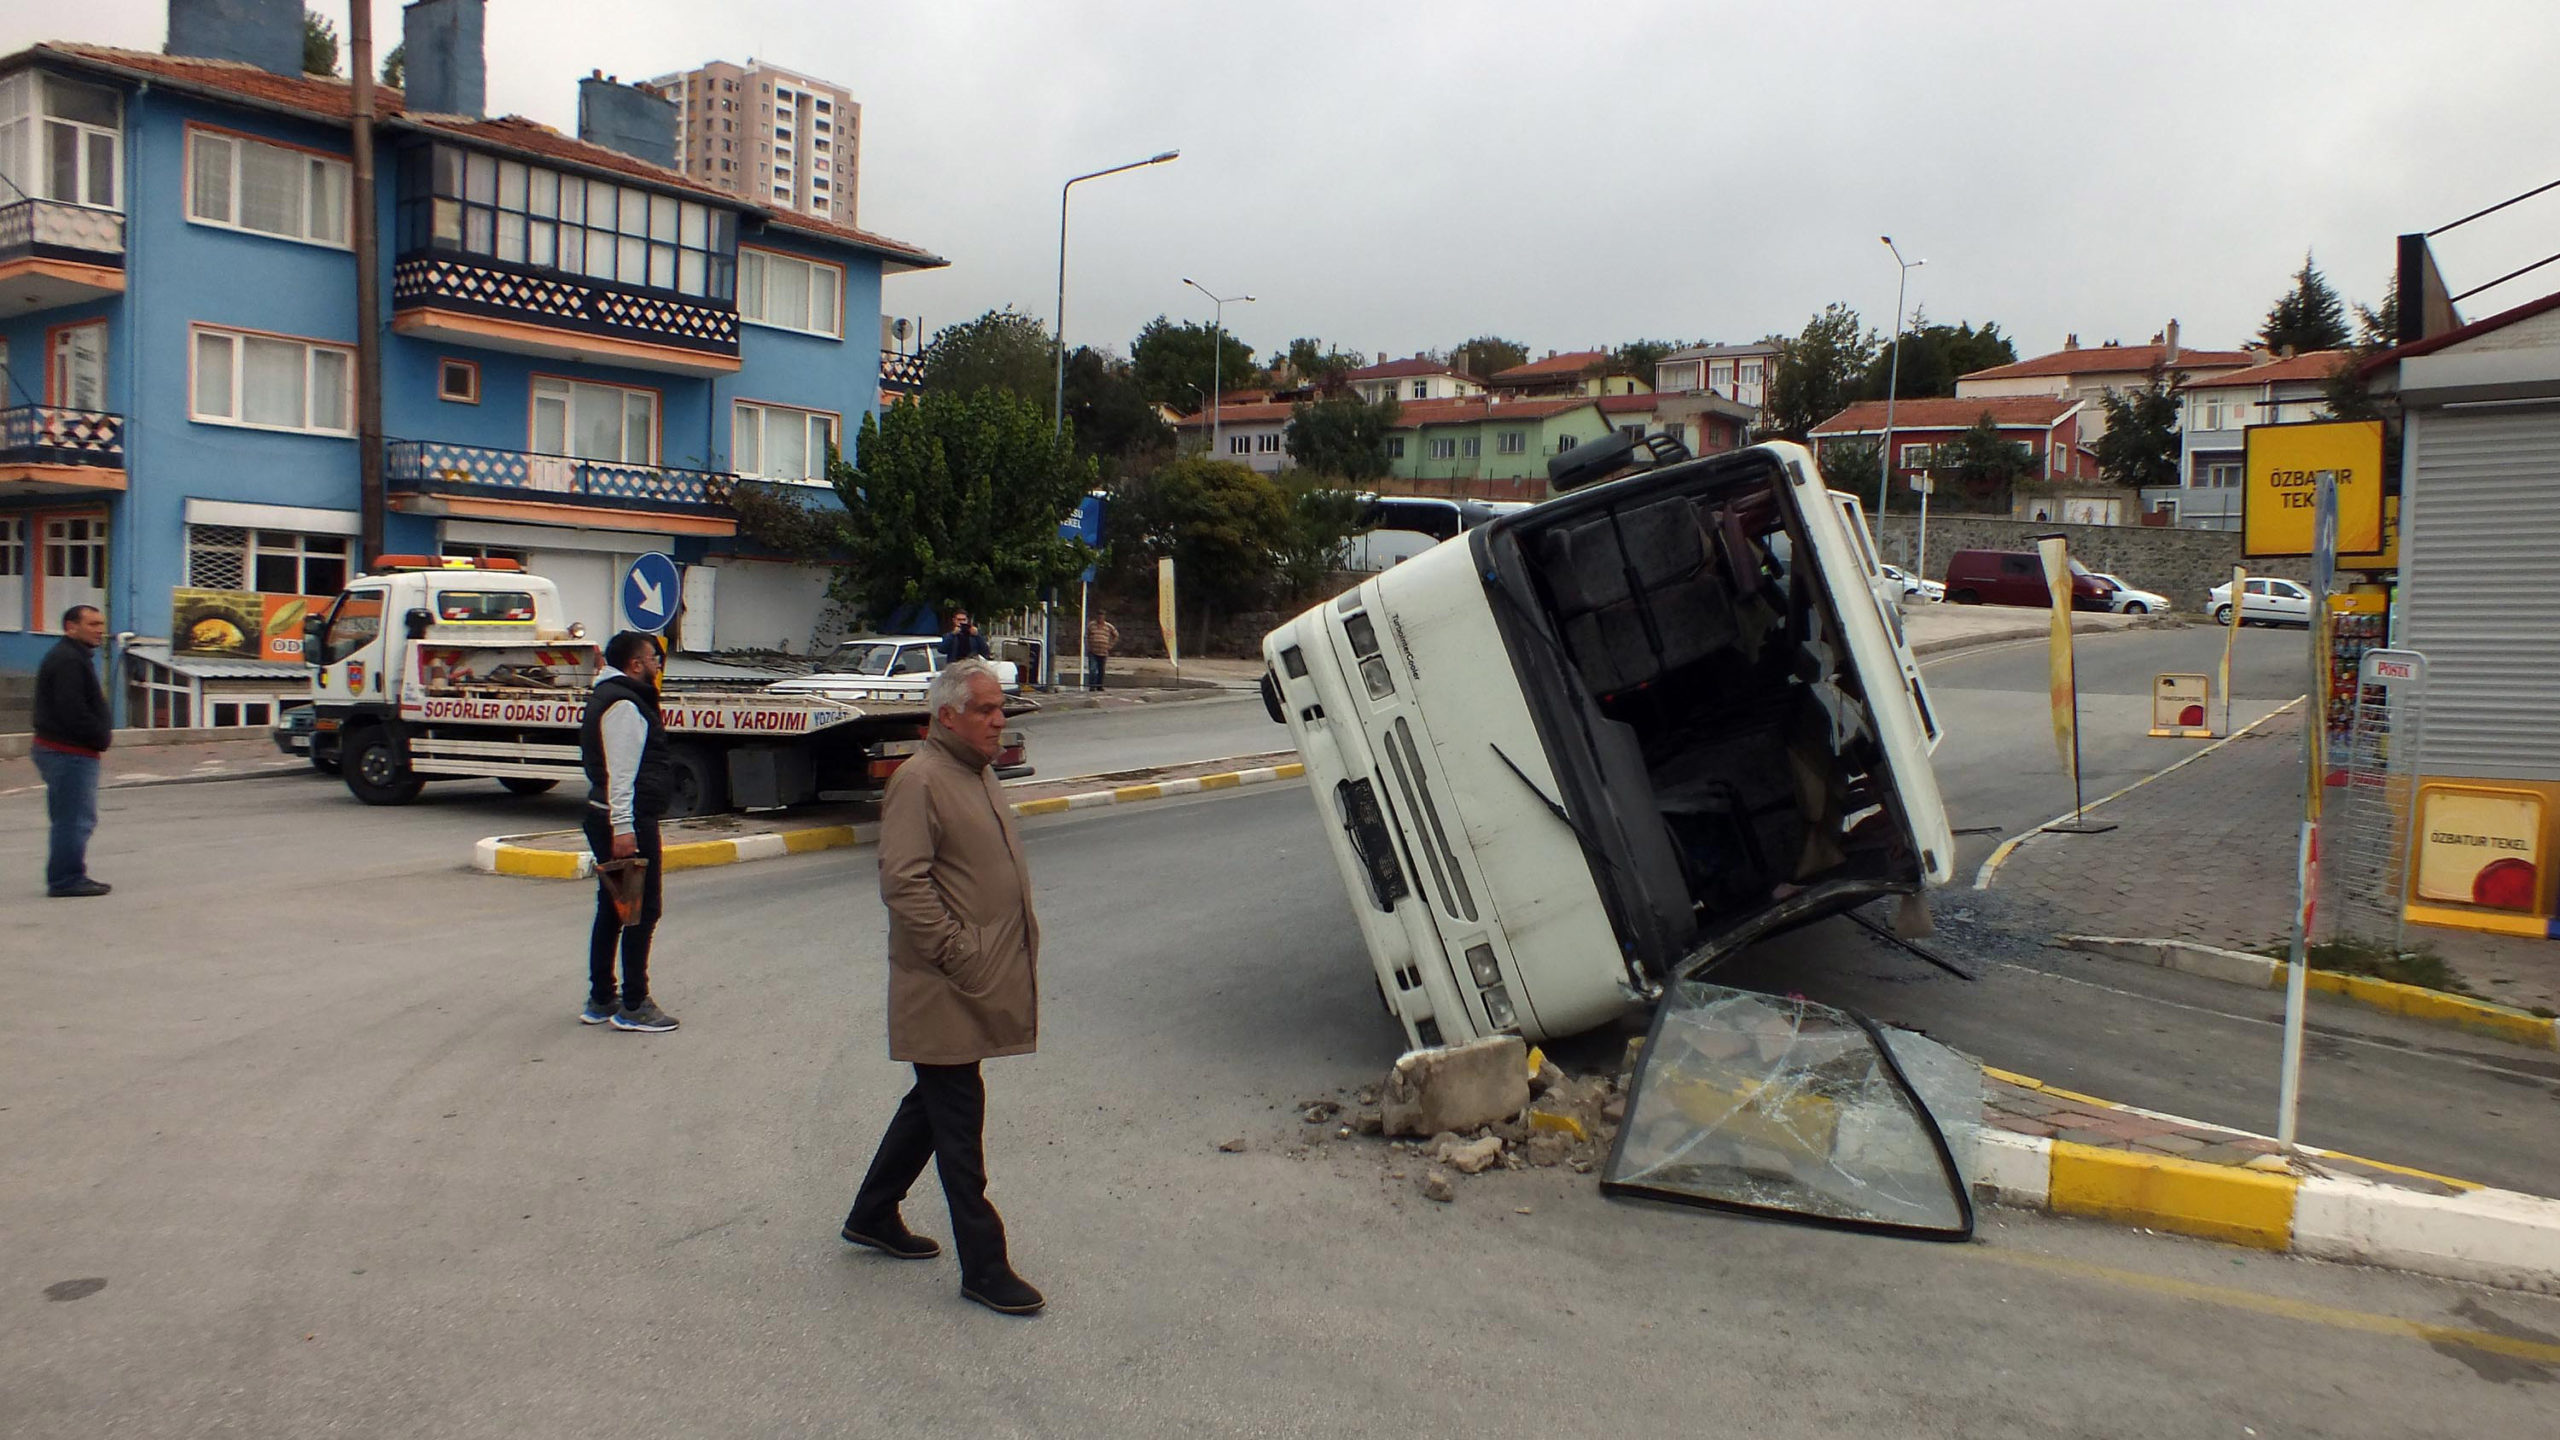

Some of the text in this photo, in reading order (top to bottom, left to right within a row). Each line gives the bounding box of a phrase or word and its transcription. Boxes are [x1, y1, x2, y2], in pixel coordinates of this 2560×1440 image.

[2280, 492, 2316, 508] TEK
[504, 704, 551, 722] ODASI
[661, 709, 685, 727] MA
[691, 710, 725, 728] YOL
[732, 711, 807, 730] YARDIMI
[2431, 829, 2530, 851] ÖZBATUR TEKEL
